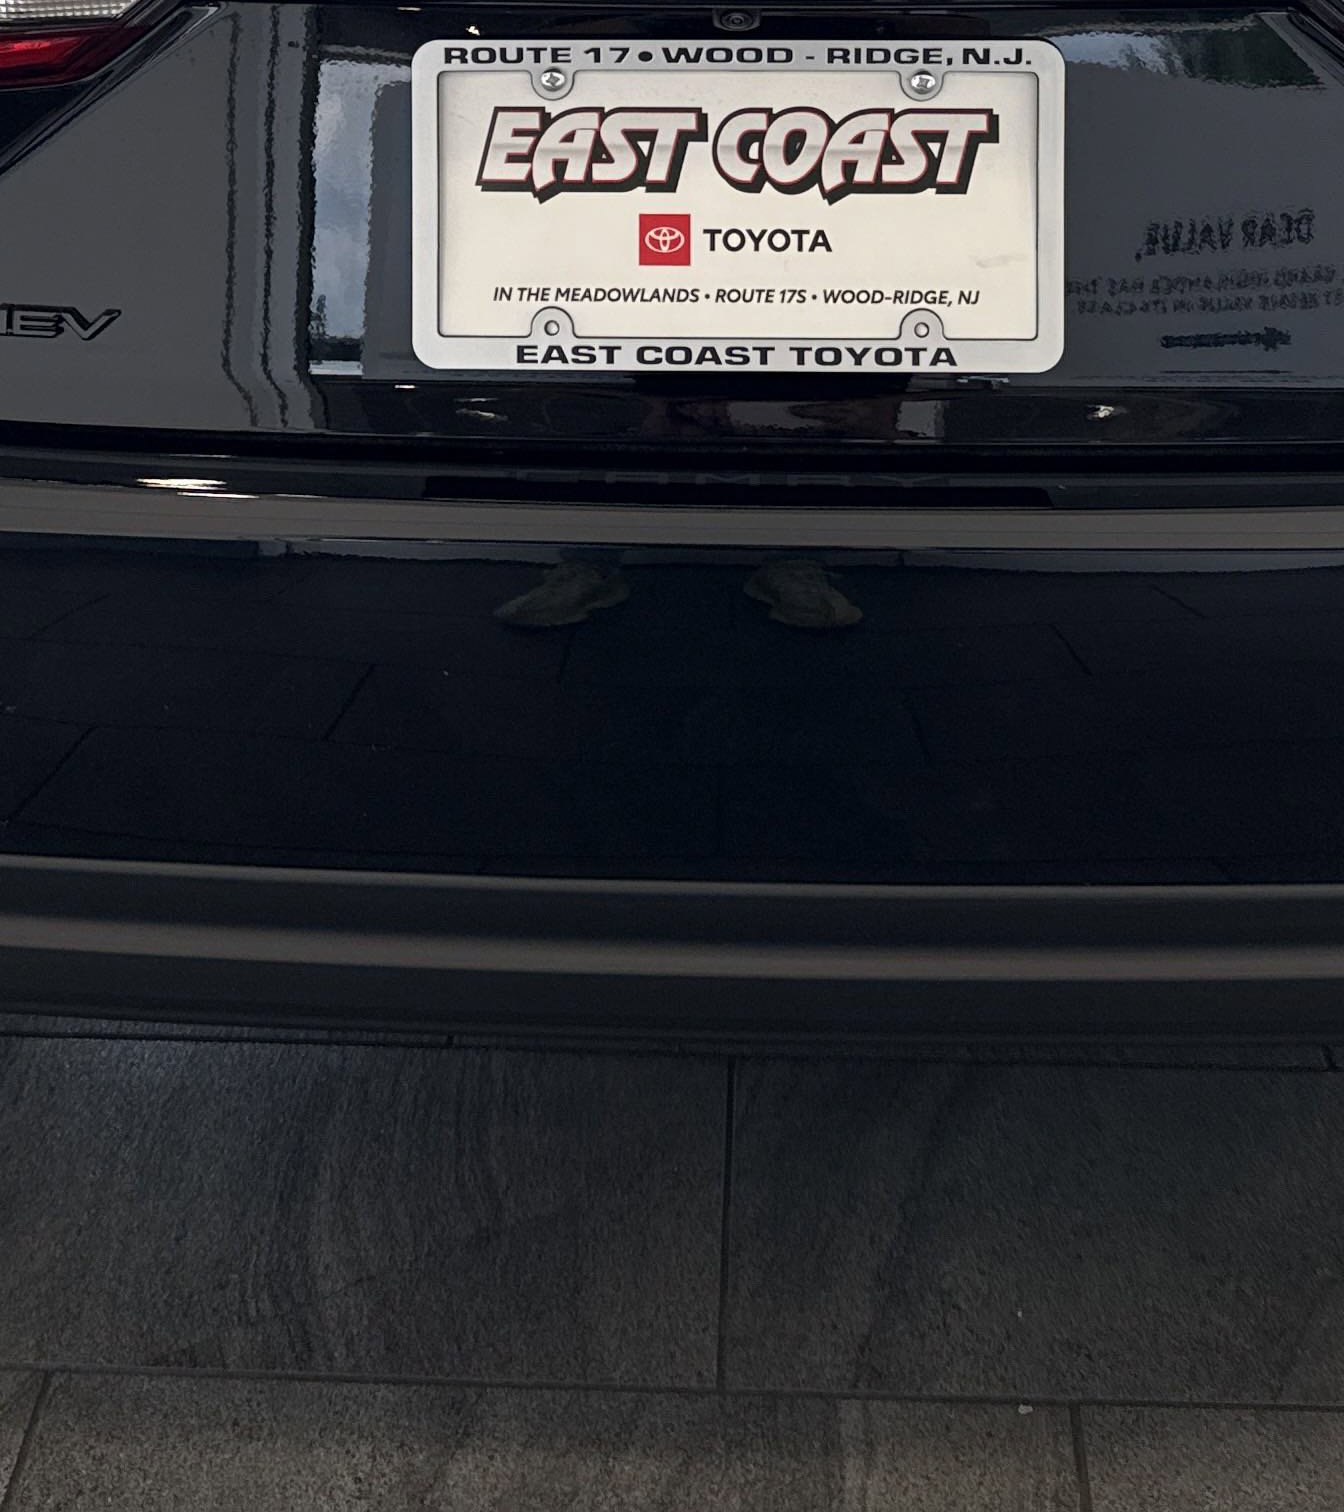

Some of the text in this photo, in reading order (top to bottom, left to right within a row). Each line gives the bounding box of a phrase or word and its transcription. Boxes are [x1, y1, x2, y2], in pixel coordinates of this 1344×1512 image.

[443, 47, 573, 65] ROUTE
[584, 47, 631, 65] 17
[662, 47, 793, 65] WOOD
[826, 48, 955, 68] RIDGE,
[962, 49, 1033, 66] N.J.
[476, 106, 1000, 205] EAST COAST
[702, 228, 833, 253] TOYOTA
[492, 287, 980, 308] IN THE MEADOWLANDS ROUTE 17S WOOD-RIDGE, NJ
[515, 345, 958, 367] EAST COAST TOYOTA
